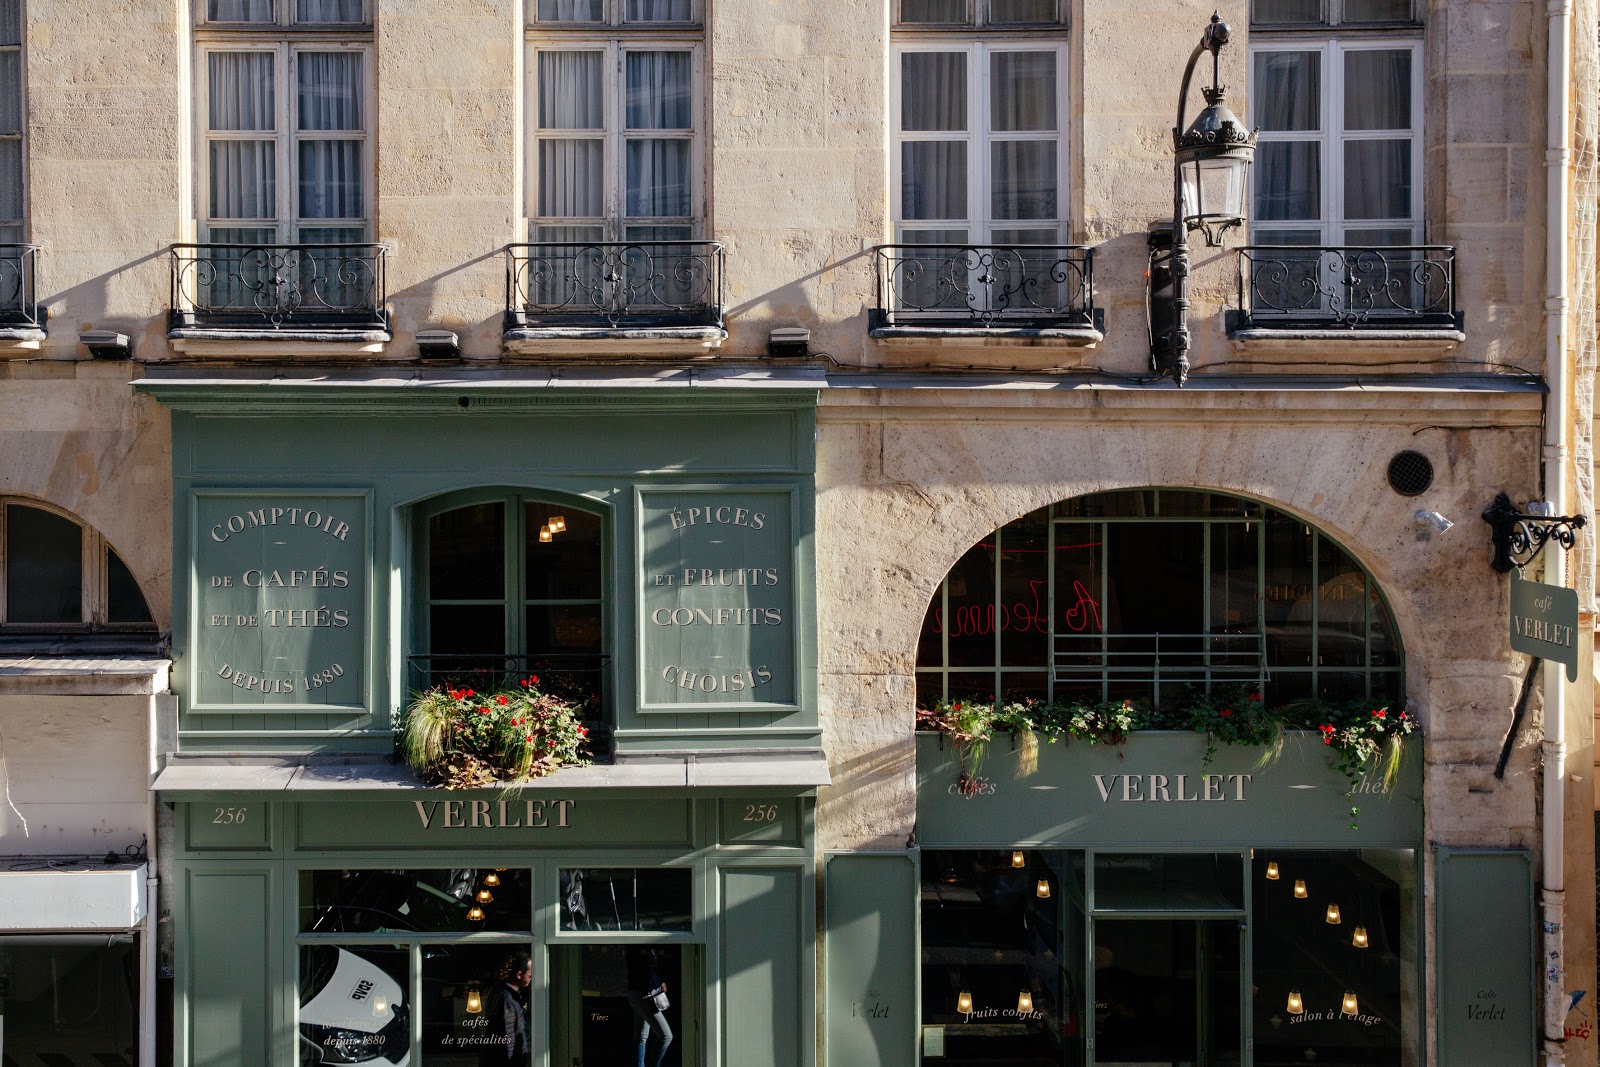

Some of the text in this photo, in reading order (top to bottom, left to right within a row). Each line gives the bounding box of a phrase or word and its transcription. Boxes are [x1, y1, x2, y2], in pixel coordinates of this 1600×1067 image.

[211, 507, 350, 542] COMPTOIR
[668, 506, 766, 530] ÉPICES
[211, 566, 350, 588] DE CAFÉS
[655, 568, 779, 586] ET FRUITS
[1535, 595, 1553, 613] café
[211, 606, 350, 627] ET DE THÉS
[652, 608, 782, 626] CONFITS
[1515, 615, 1573, 648] VERLET
[217, 663, 345, 694] DEPUIS 1880
[662, 665, 772, 693] CHOISIS
[1092, 774, 1253, 802] VERLET
[1351, 775, 1390, 794] thés
[212, 807, 247, 824] 256
[412, 800, 576, 829] VERLET
[743, 804, 778, 822] 256
[591, 1013, 609, 1021] Tirez
[852, 1002, 891, 1019] Verlet
[963, 1007, 1044, 1024] fruits confits
[1290, 1010, 1322, 1025] salon
[1327, 1009, 1334, 1020] à
[1468, 1004, 1506, 1020] Verlet
[462, 1016, 489, 1029] cafés
[323, 1035, 386, 1048] depuis 1880
[442, 1034, 512, 1048] de spécialités
